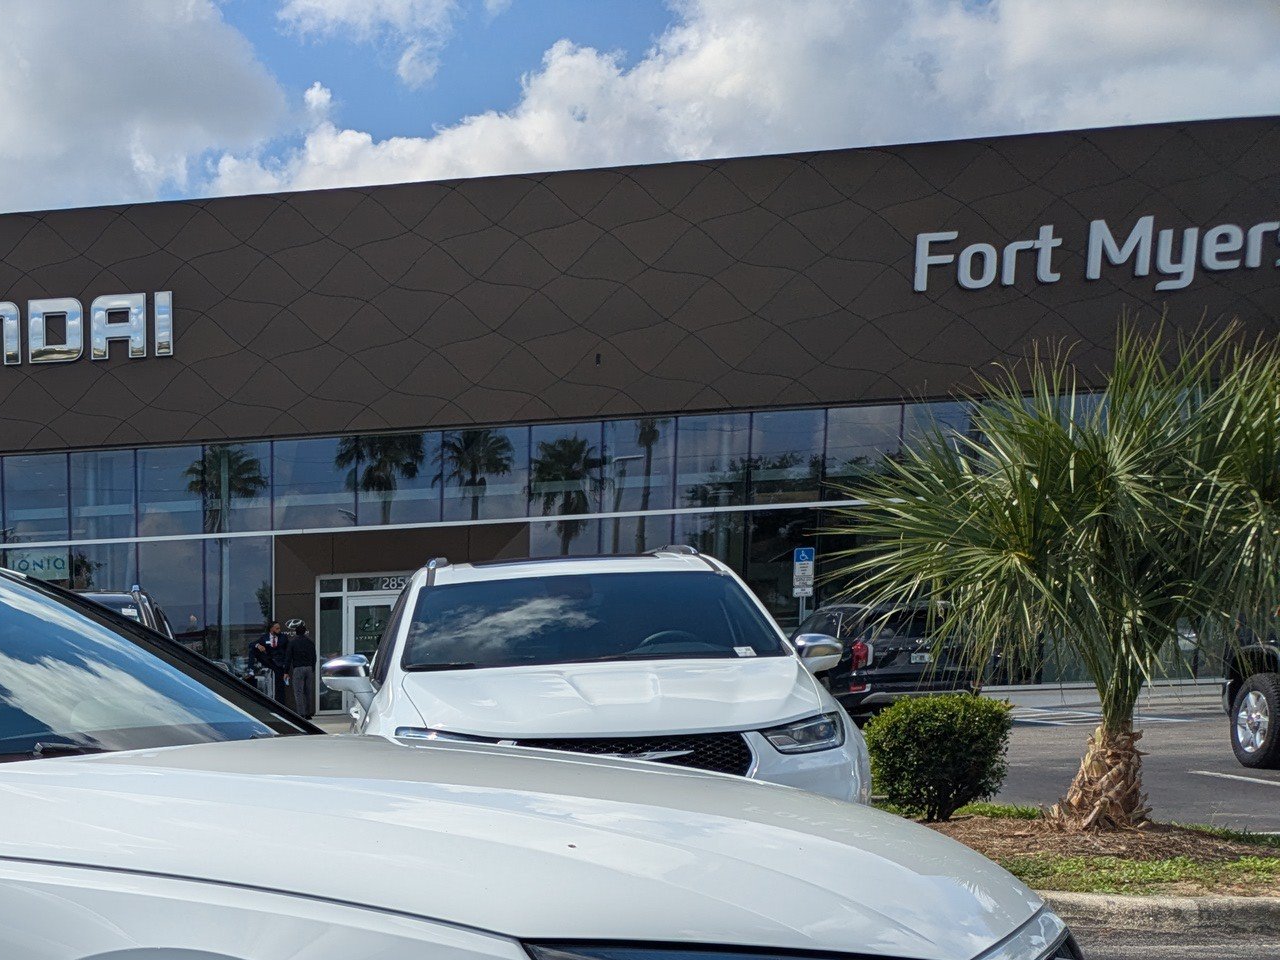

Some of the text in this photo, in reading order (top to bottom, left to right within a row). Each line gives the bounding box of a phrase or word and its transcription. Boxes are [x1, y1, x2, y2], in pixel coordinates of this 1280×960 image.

[913, 215, 1280, 292] Fort Myer
[11, 557, 66, 571] IONIQ
[381, 577, 411, 590] 285
